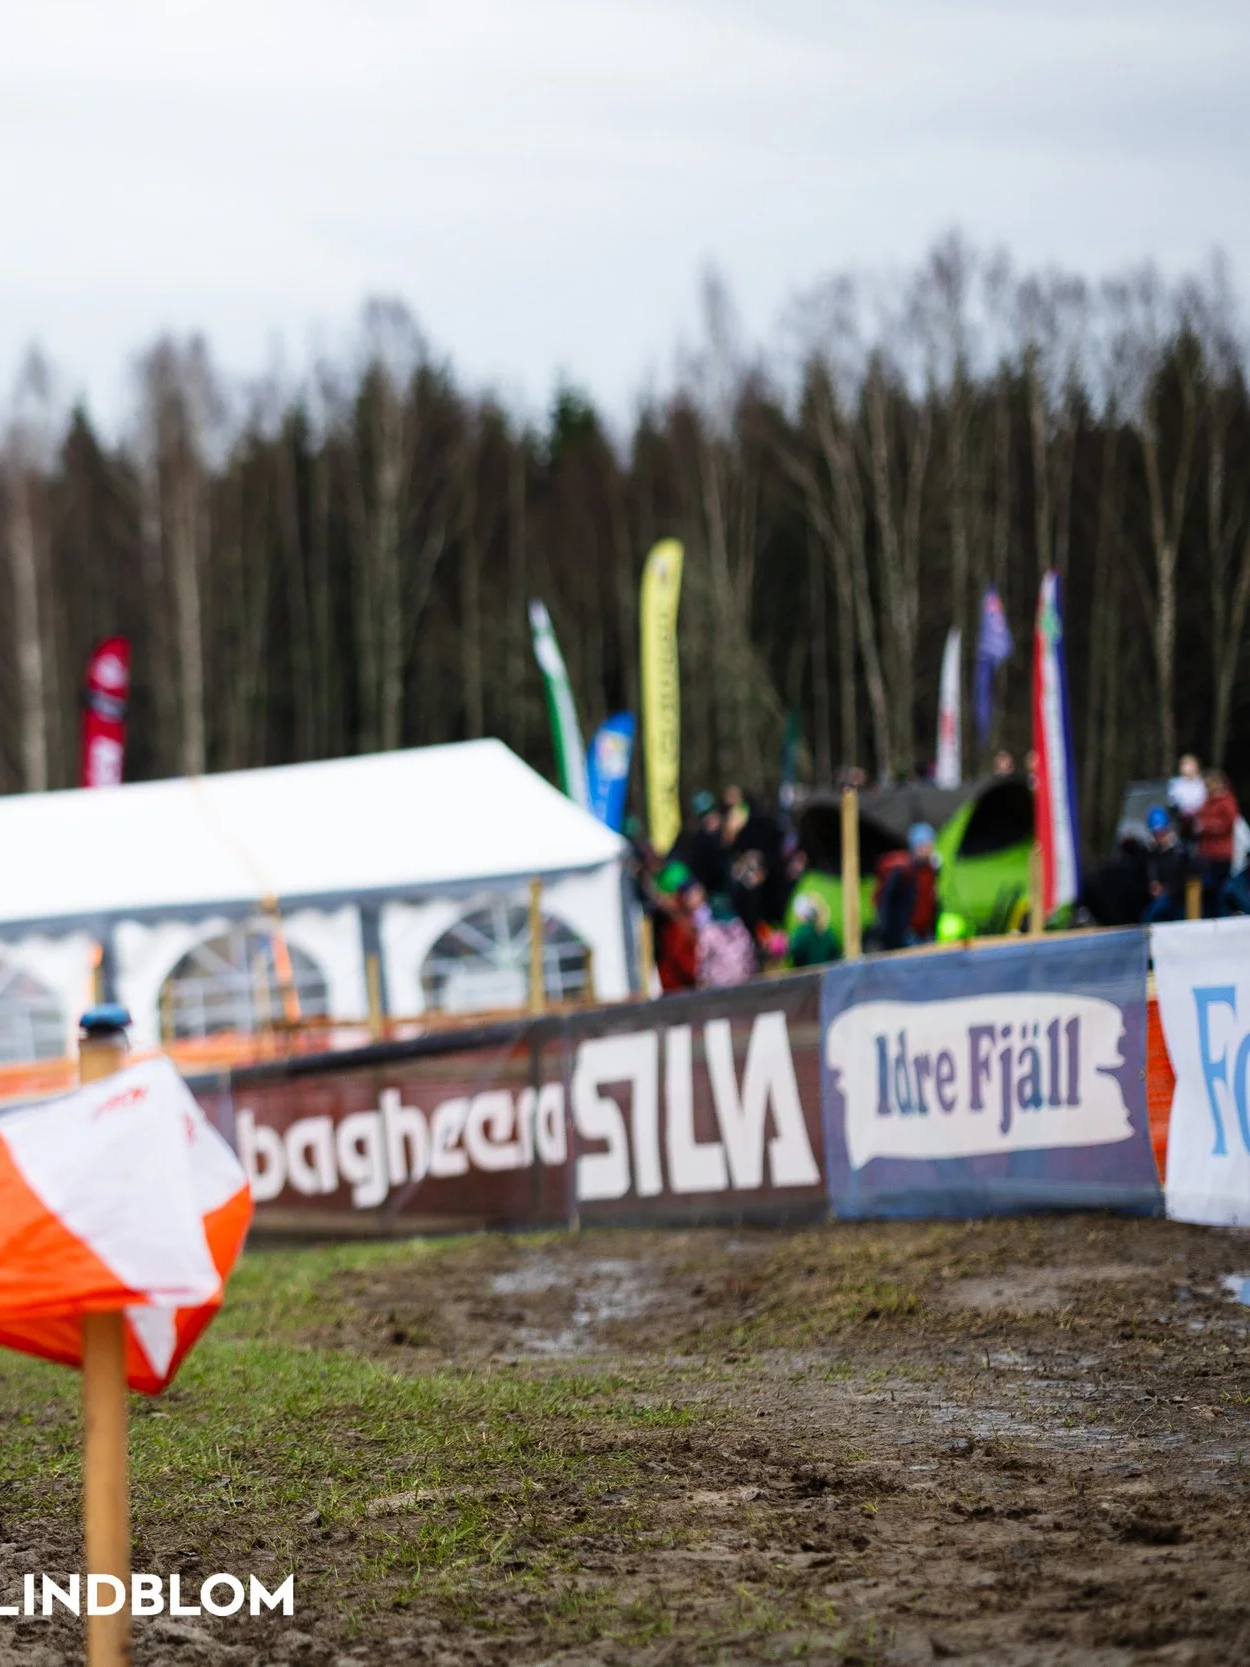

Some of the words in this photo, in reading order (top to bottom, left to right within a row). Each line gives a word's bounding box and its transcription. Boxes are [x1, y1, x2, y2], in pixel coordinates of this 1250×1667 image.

[571, 1010, 821, 1200] SILVA
[876, 1030, 958, 1118] Idre
[968, 1015, 1082, 1136] Fjäll
[236, 1081, 566, 1209] bagheera
